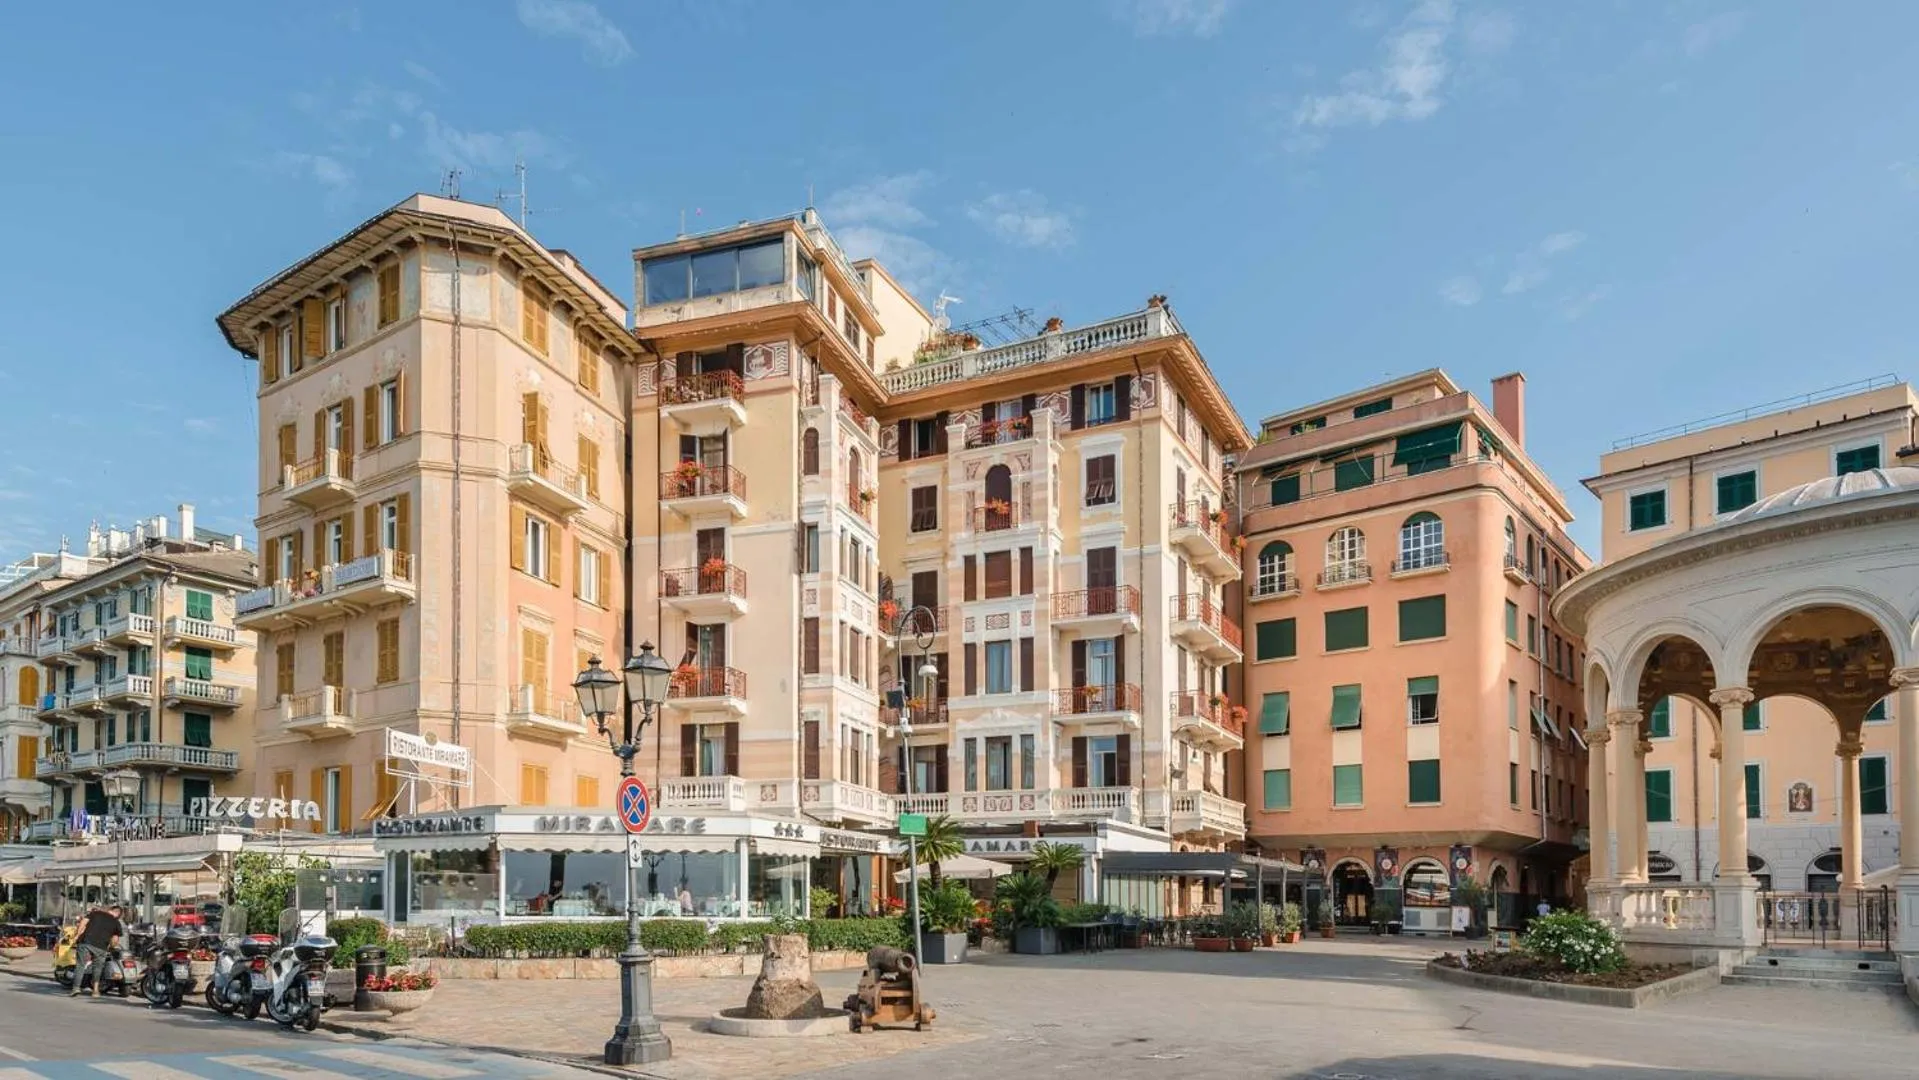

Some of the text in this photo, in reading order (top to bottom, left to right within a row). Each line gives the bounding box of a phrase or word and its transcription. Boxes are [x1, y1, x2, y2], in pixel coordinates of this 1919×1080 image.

[392, 735, 466, 767] RISTORANTE MIRAMARE
[190, 796, 321, 821] PIZZERIA
[376, 816, 485, 834] RISTORANTE
[535, 816, 706, 834] MIRAARE
